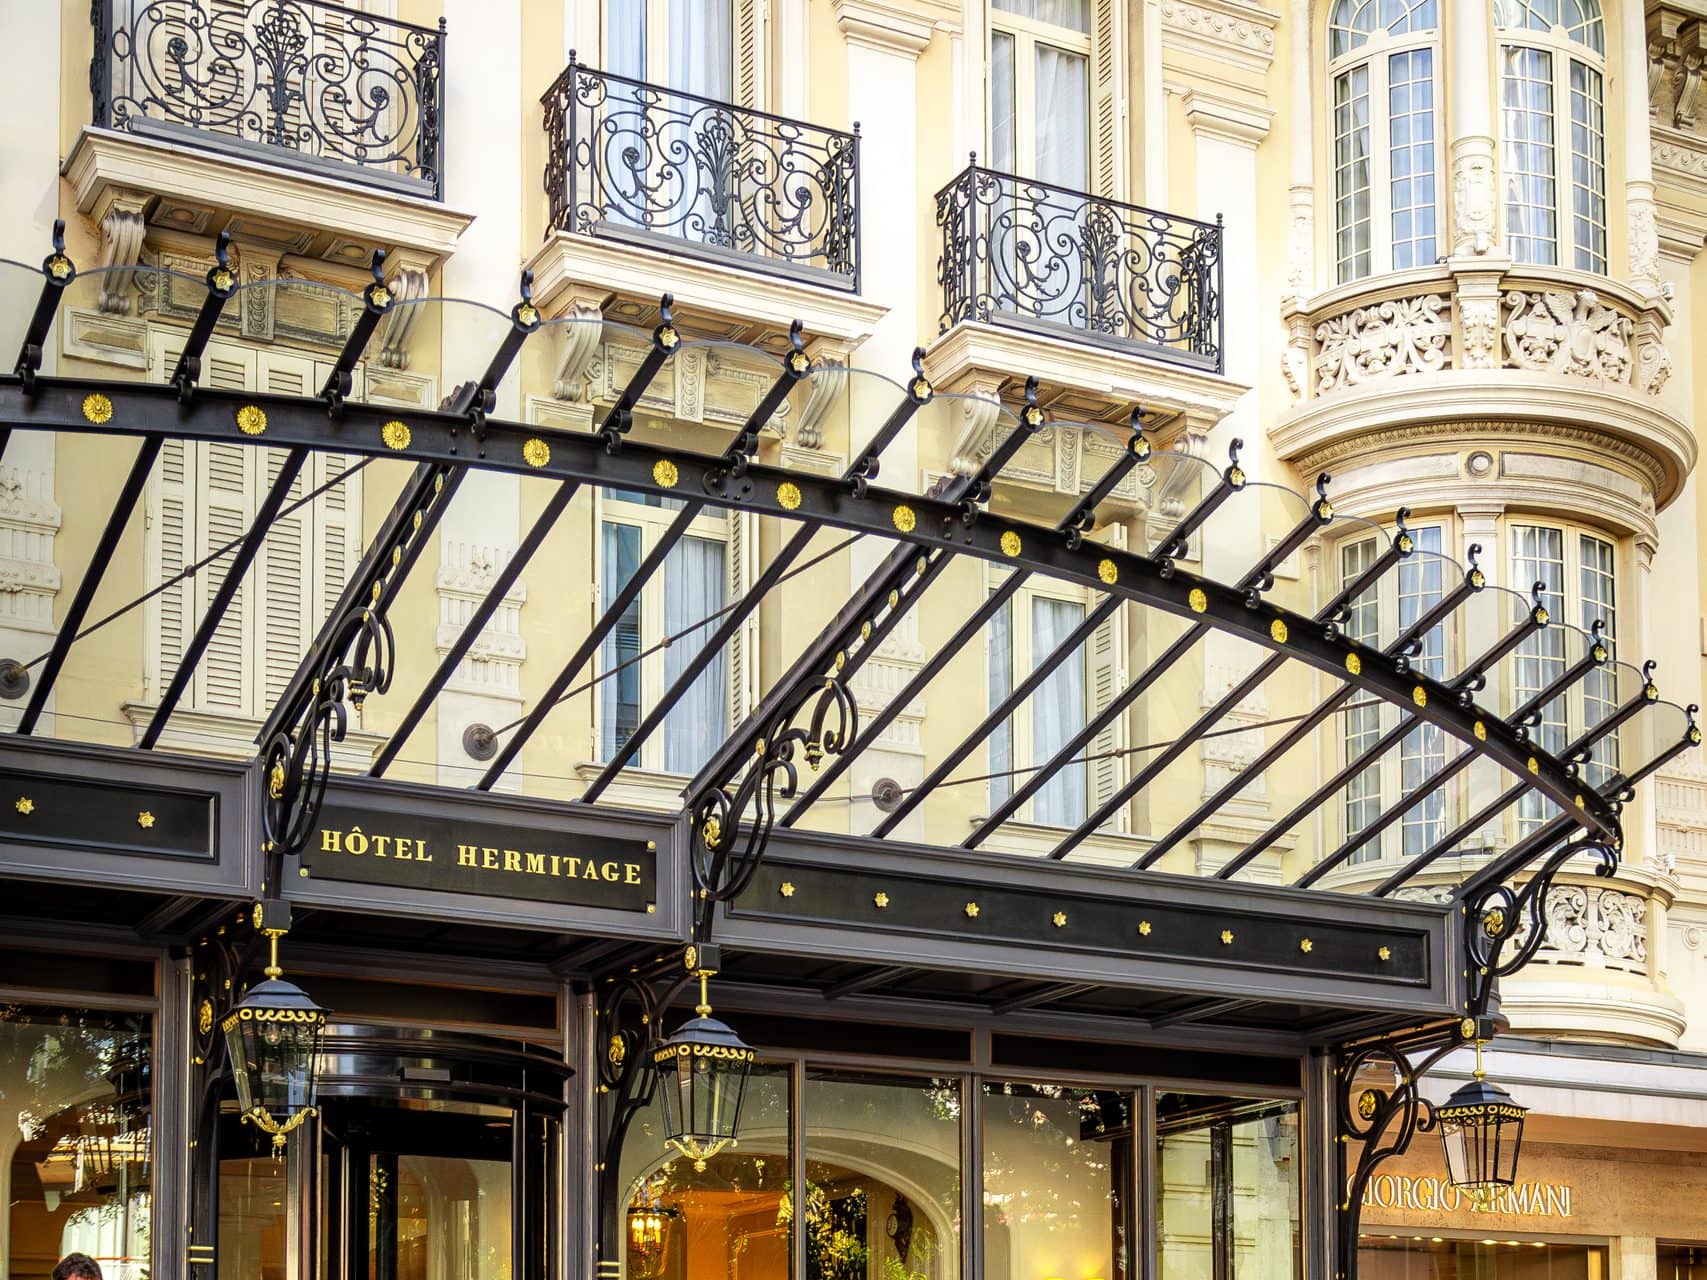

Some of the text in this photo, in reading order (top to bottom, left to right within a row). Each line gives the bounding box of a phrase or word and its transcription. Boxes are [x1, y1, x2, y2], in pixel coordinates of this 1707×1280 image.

[320, 826, 642, 885] HÔTEL HERMITAGE
[1470, 1182, 1573, 1217] ARMANI
